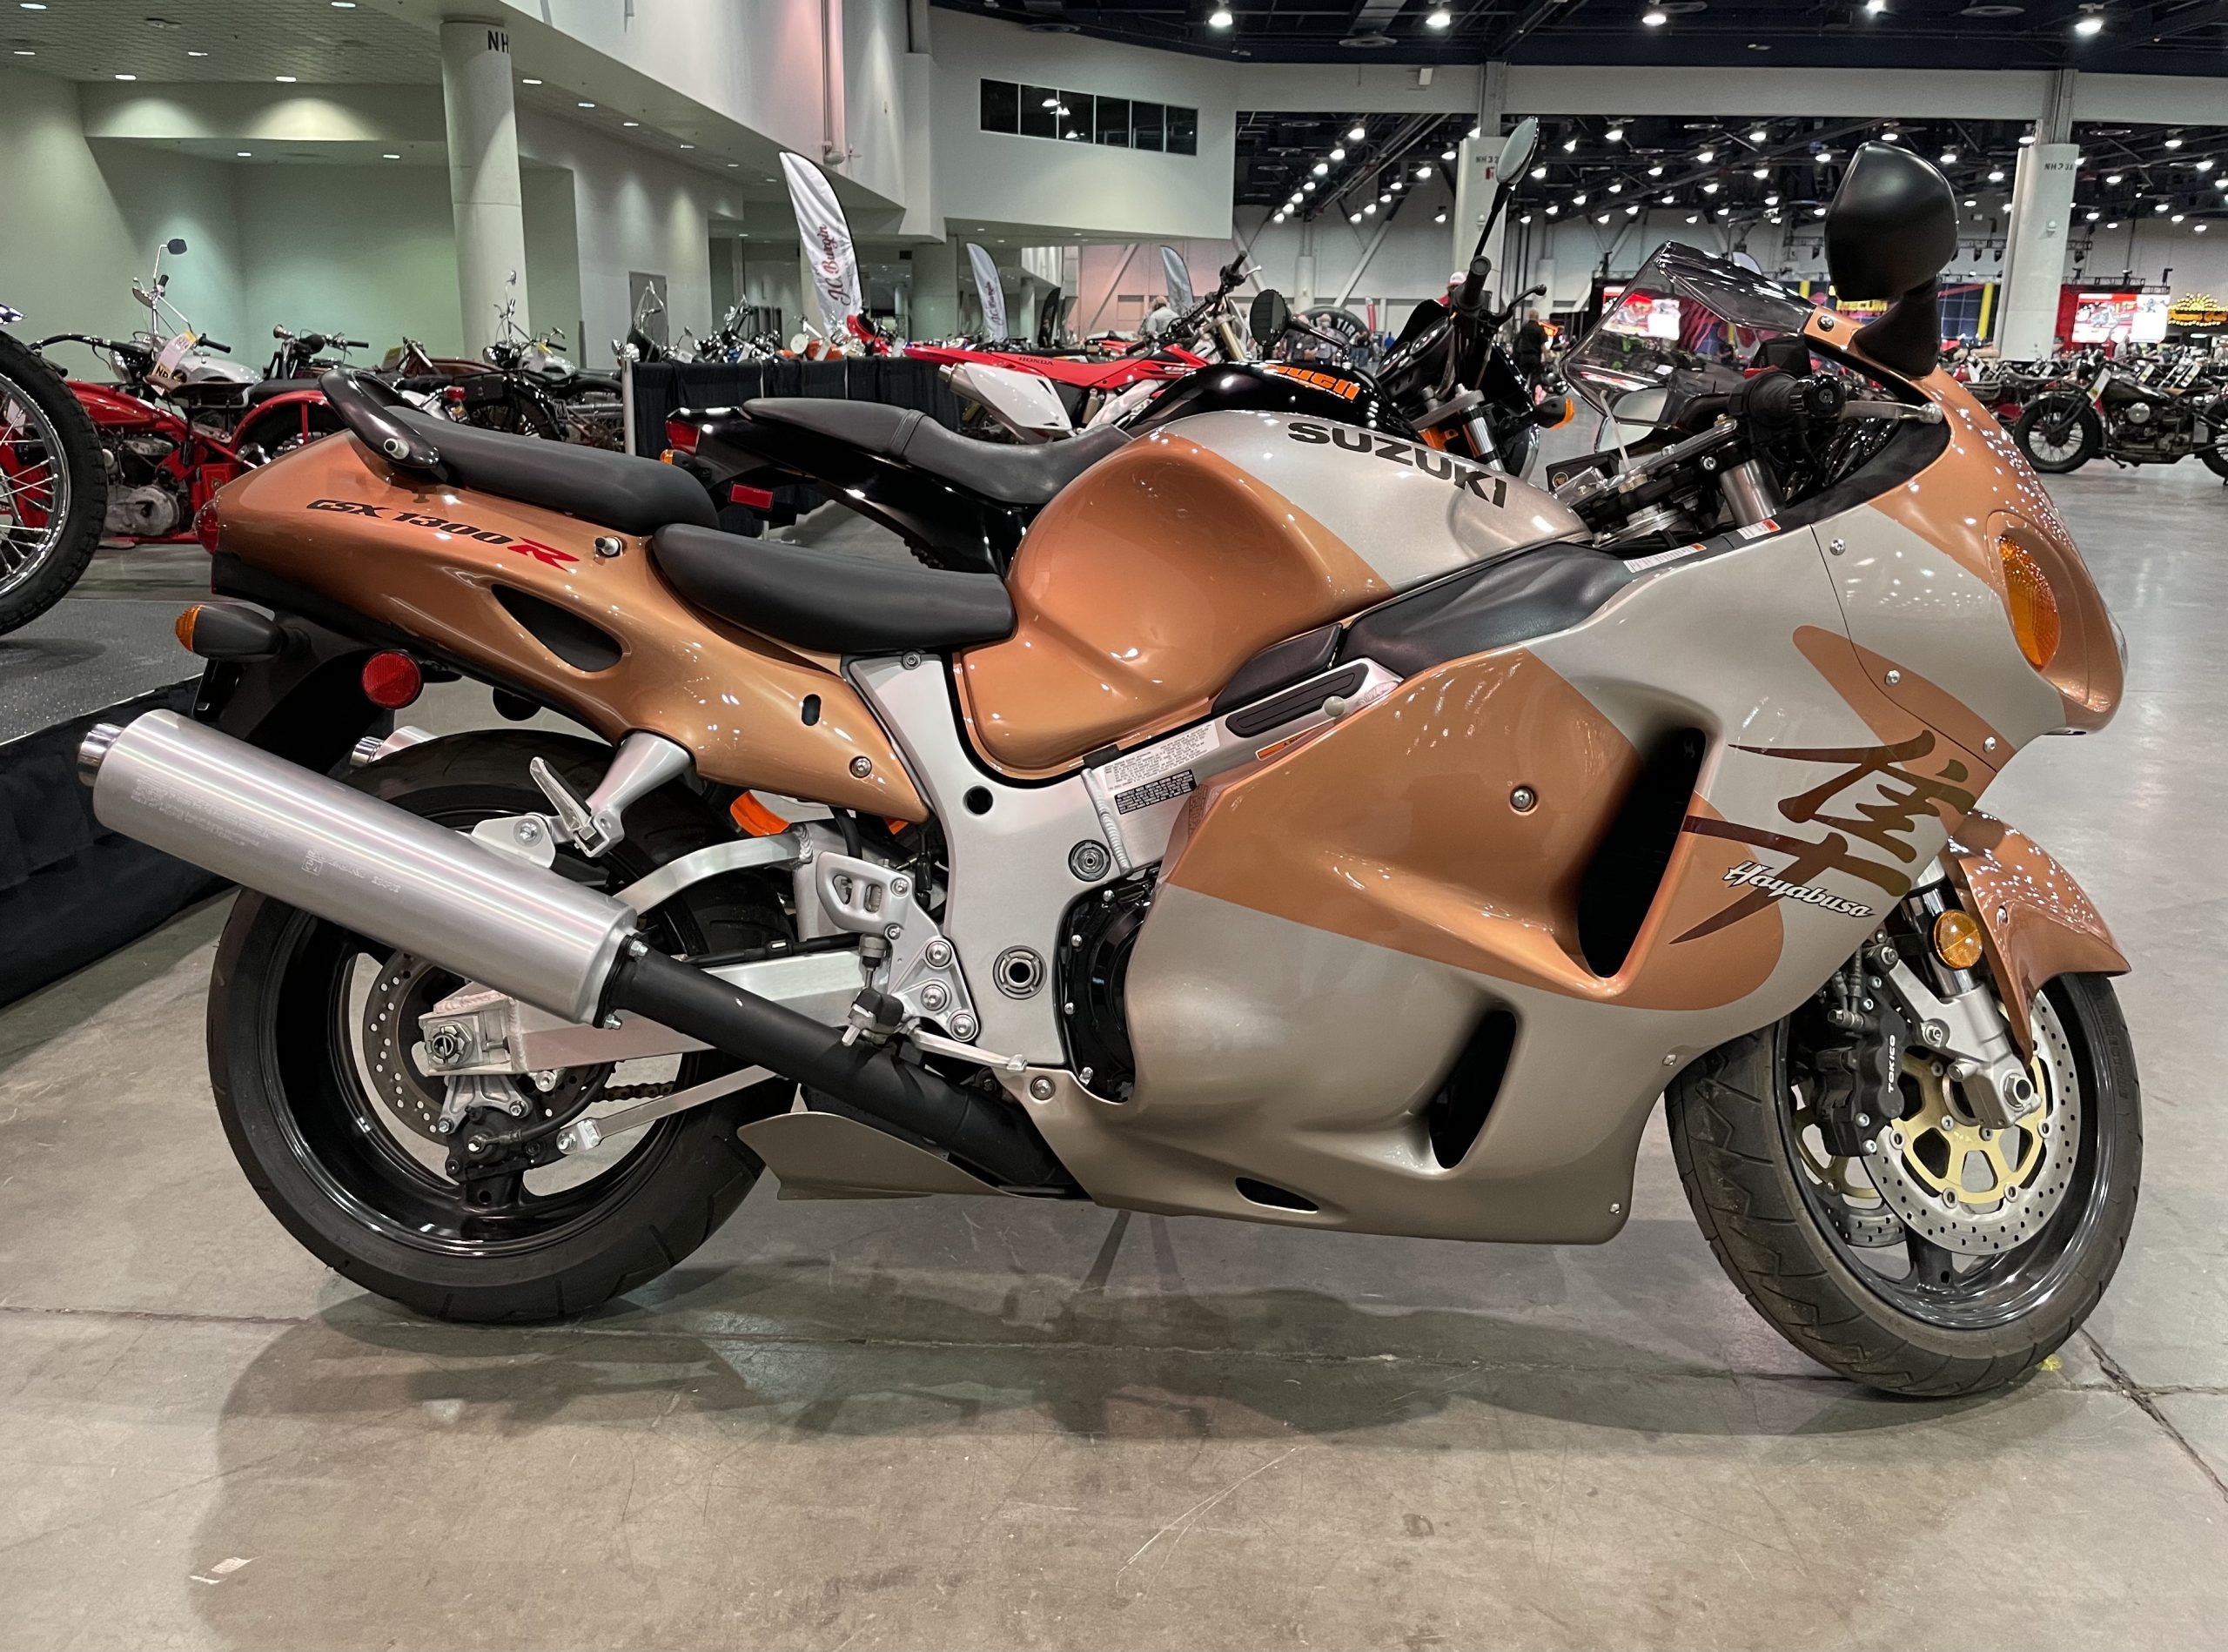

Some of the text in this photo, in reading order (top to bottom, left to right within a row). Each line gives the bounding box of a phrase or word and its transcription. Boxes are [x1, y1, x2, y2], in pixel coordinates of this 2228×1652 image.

[816, 224, 840, 275] Burgin
[1017, 356, 1055, 366] HONDA
[1287, 422, 1507, 508] SUZUKI
[305, 499, 393, 519] GSX
[1721, 860, 1876, 918] Hayabusa
